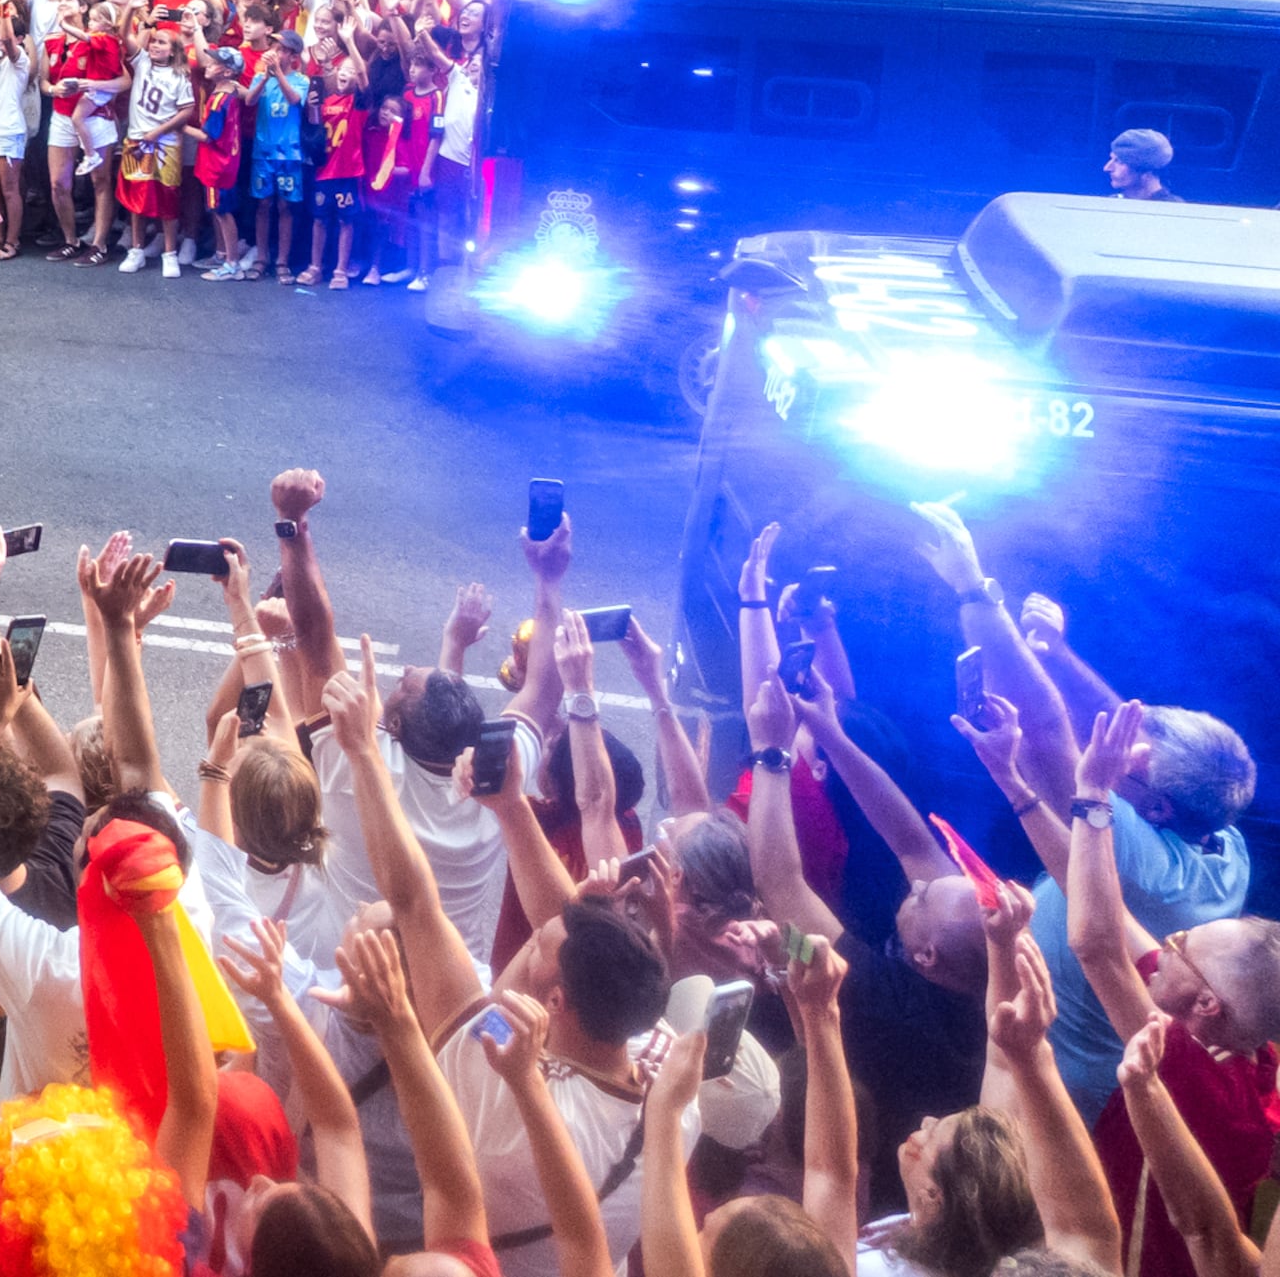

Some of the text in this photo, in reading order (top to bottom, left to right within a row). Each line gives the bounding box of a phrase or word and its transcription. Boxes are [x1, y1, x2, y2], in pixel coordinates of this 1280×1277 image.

[137, 79, 163, 115] 19
[271, 102, 289, 118] 23
[276, 176, 295, 192] 23
[335, 192, 354, 208] 24
